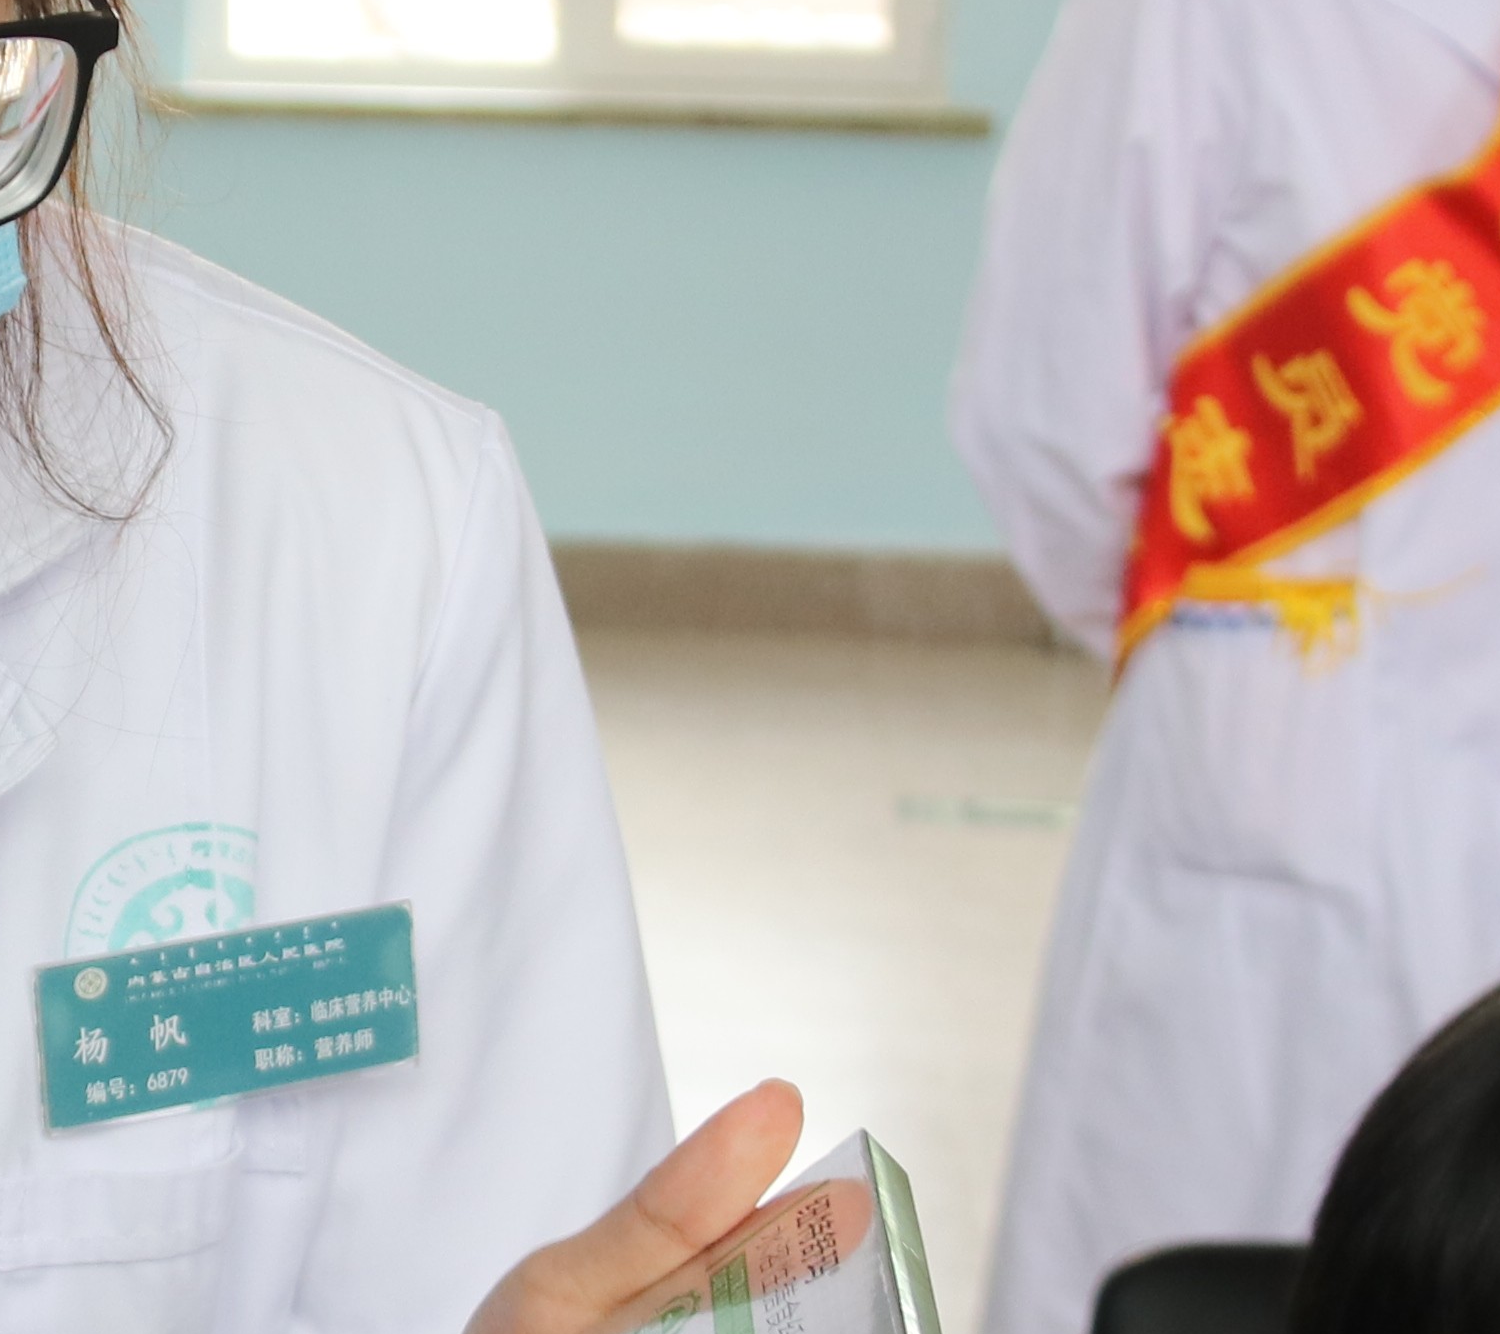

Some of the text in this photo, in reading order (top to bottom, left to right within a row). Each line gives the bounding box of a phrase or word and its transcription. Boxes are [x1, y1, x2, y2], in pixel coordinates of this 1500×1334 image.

[127, 937, 347, 989] 内蒙古自治区人民医院
